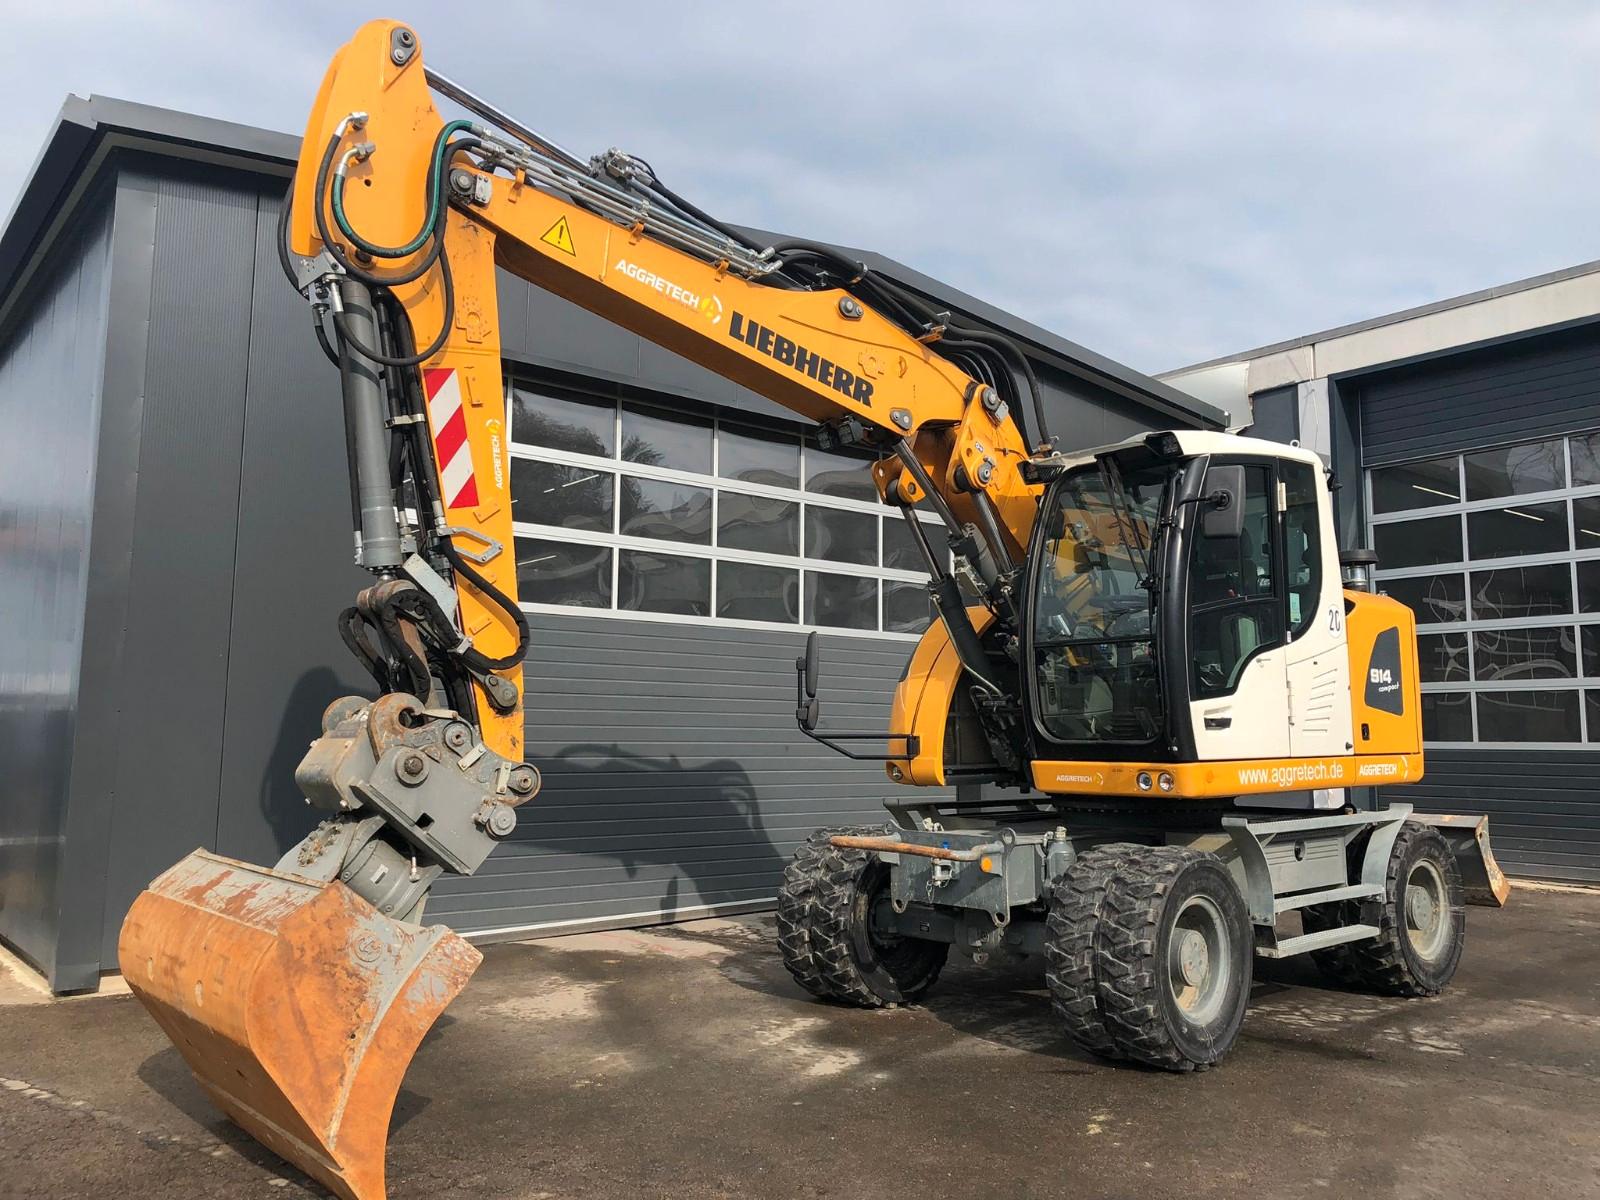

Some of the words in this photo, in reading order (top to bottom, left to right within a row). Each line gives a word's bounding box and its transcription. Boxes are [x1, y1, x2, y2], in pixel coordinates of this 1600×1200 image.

[615, 259, 700, 309] AGGRETECH
[729, 310, 874, 408] LIEBHERR
[491, 434, 503, 489] AGGRETECH
[1328, 609, 1341, 632] 20
[1370, 668, 1392, 684] 914
[1056, 774, 1092, 783] AGGRETECH
[1238, 760, 1343, 787] www.aggretech.de
[1359, 763, 1397, 777] AGGRETECH
